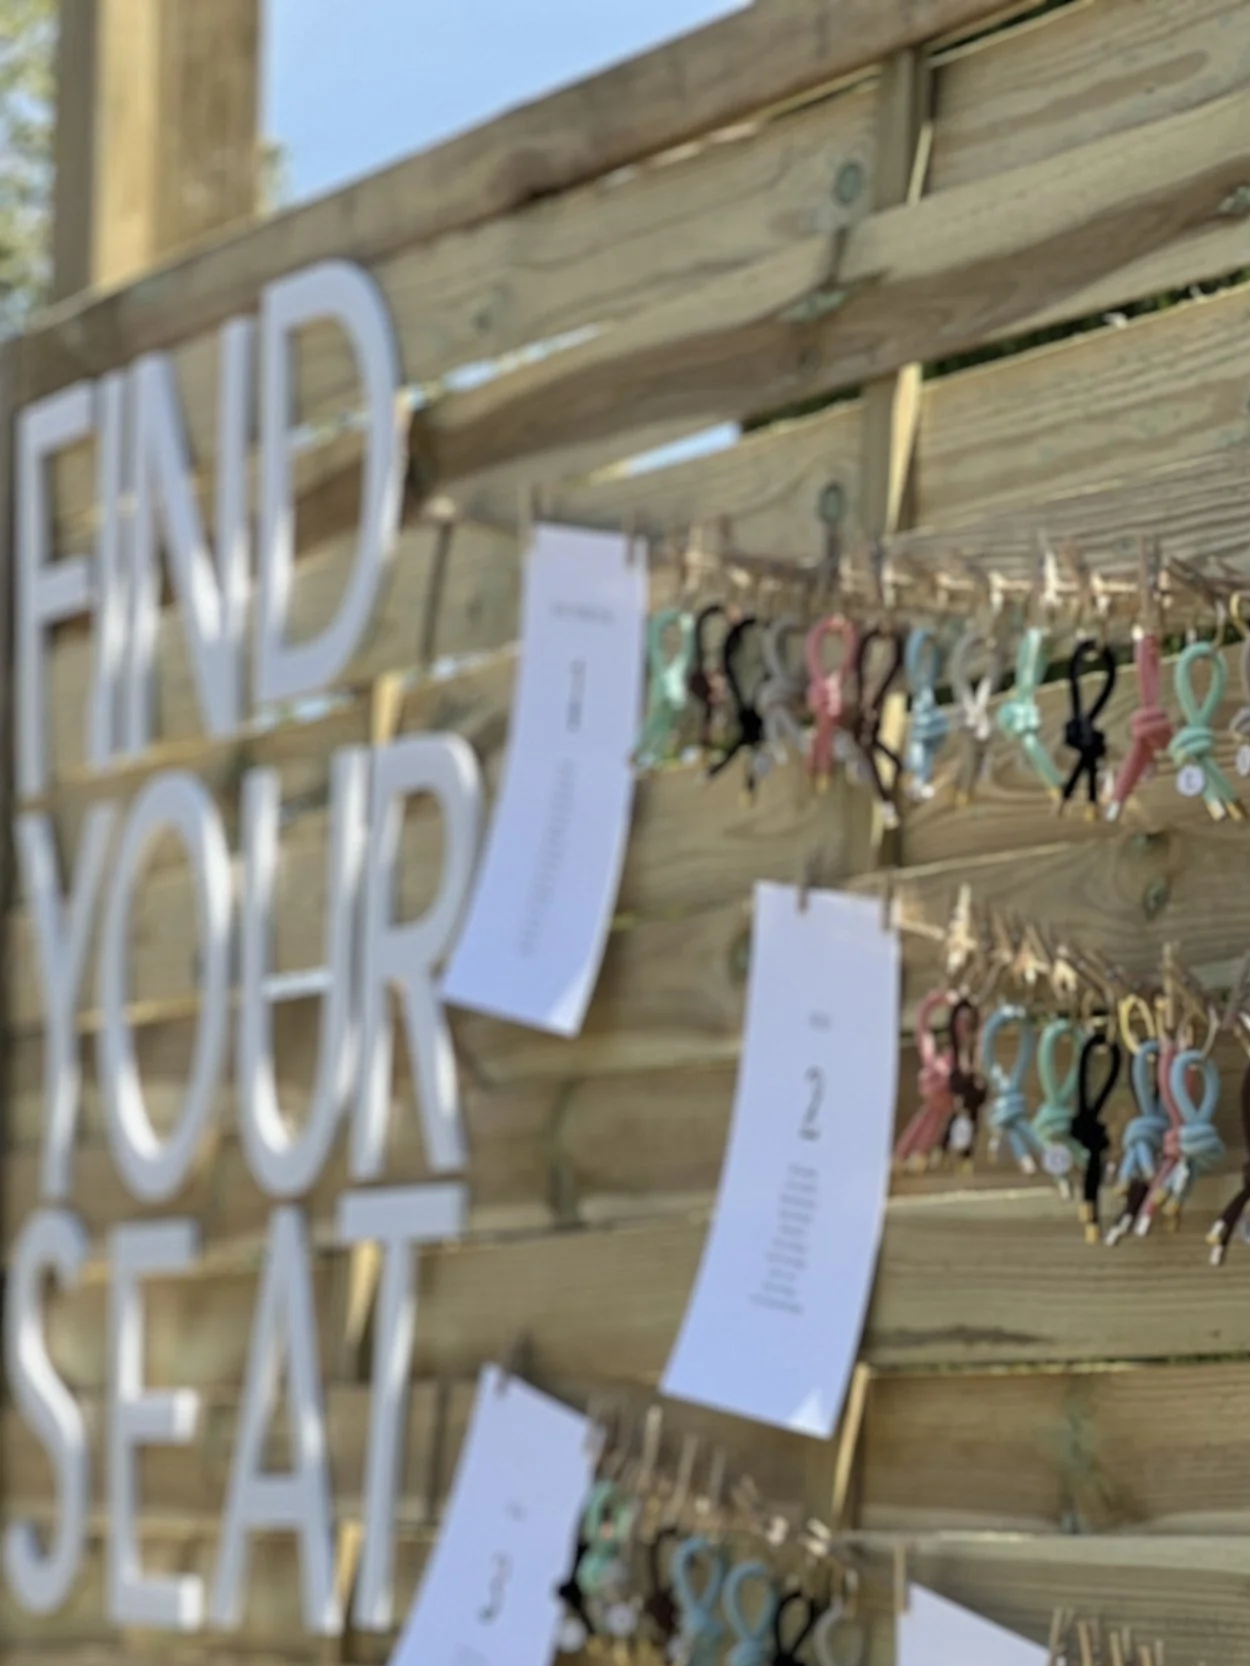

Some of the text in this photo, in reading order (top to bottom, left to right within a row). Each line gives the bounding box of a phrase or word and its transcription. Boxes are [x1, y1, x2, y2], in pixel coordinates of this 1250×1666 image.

[16, 258, 402, 798] FIND
[14, 732, 484, 1202] YOUR
[4, 1182, 470, 1638] SEAT
